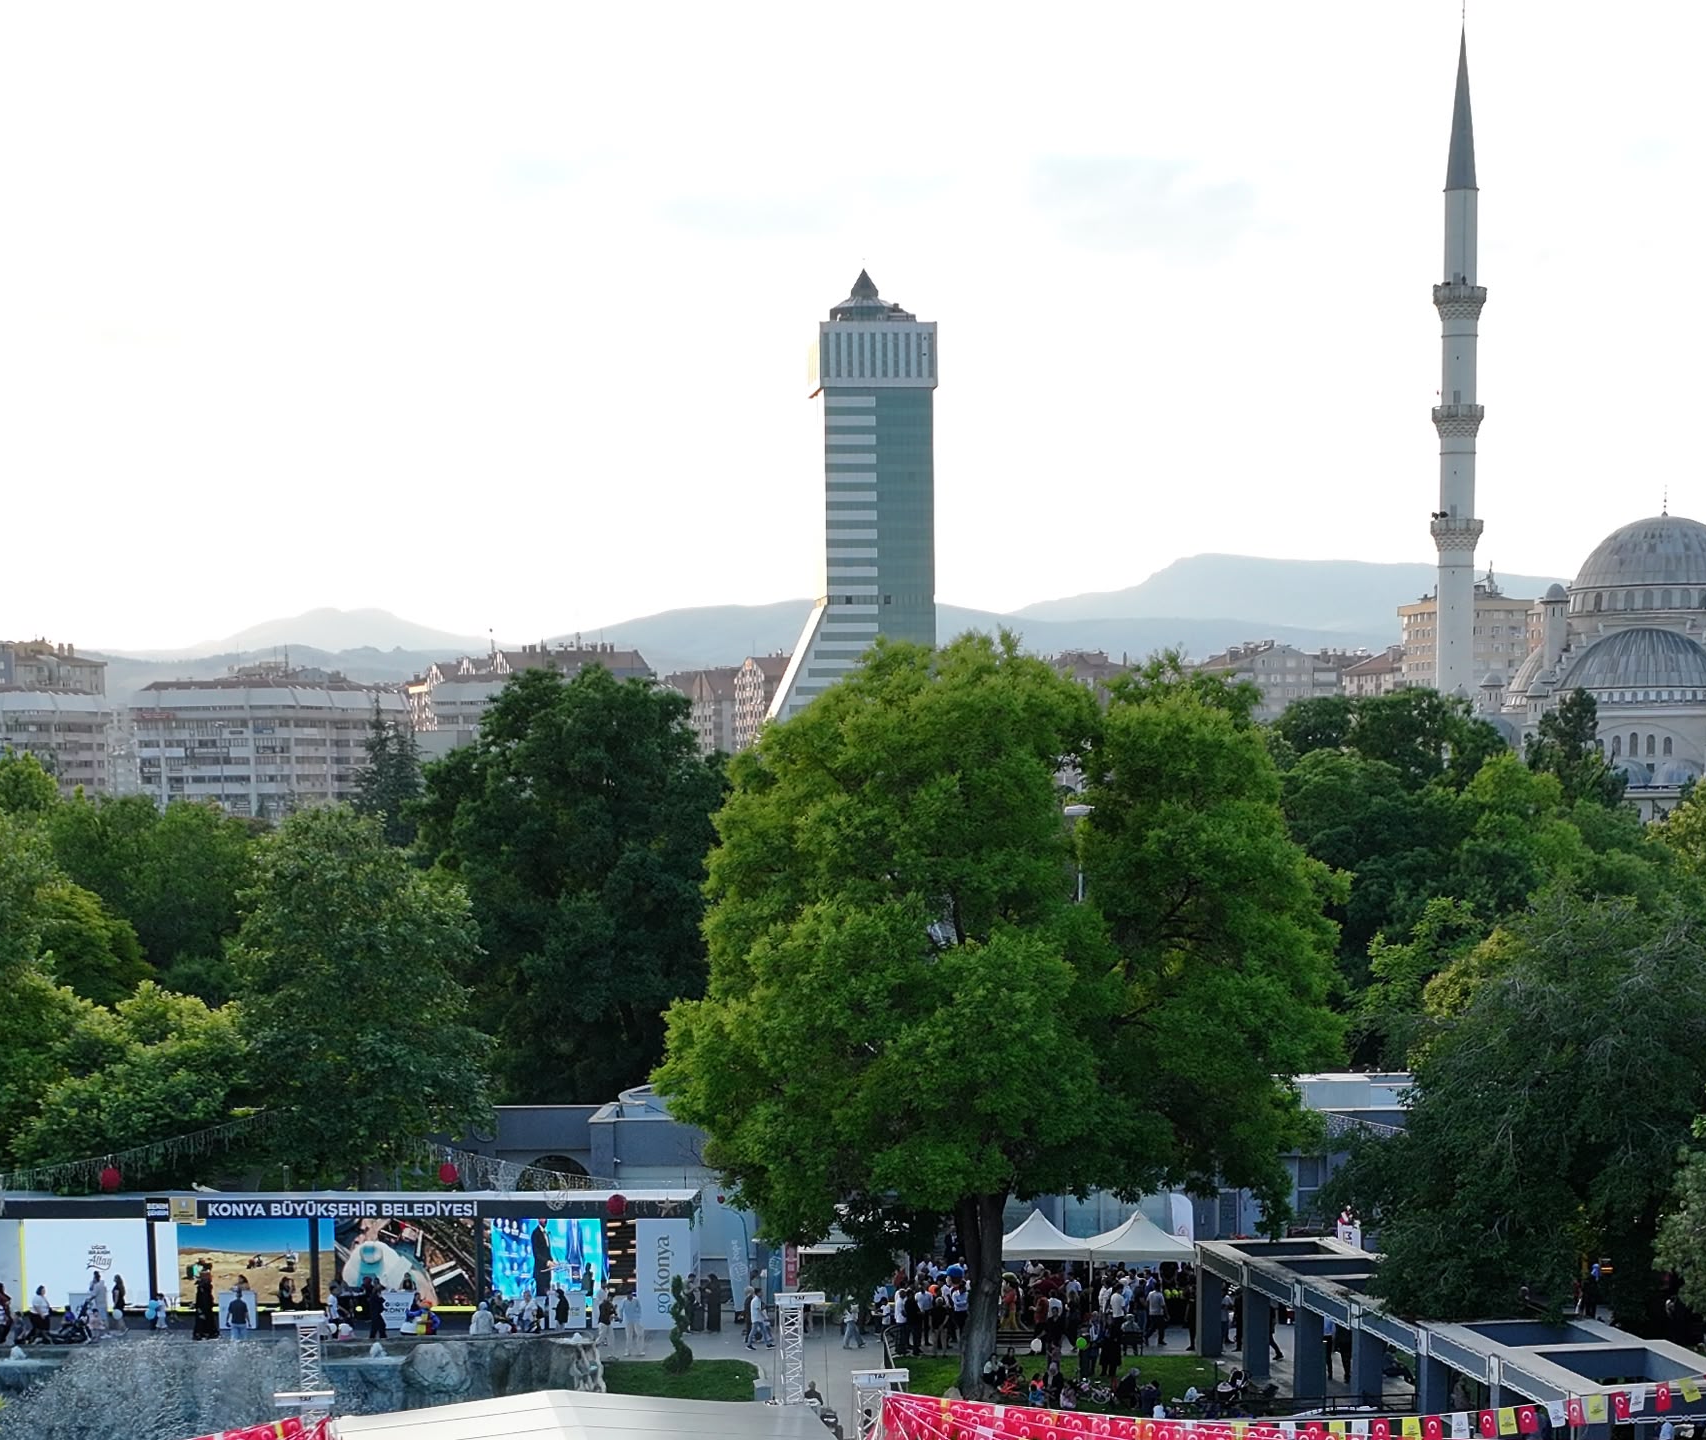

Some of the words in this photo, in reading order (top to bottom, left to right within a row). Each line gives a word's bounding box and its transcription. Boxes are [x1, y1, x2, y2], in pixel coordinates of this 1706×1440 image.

[208, 1203, 266, 1217] KONYA
[271, 1200, 379, 1218] BÜYÜKŞEHİR
[383, 1200, 478, 1217] BELEDİYESİ
[653, 1235, 675, 1314] goKonya
